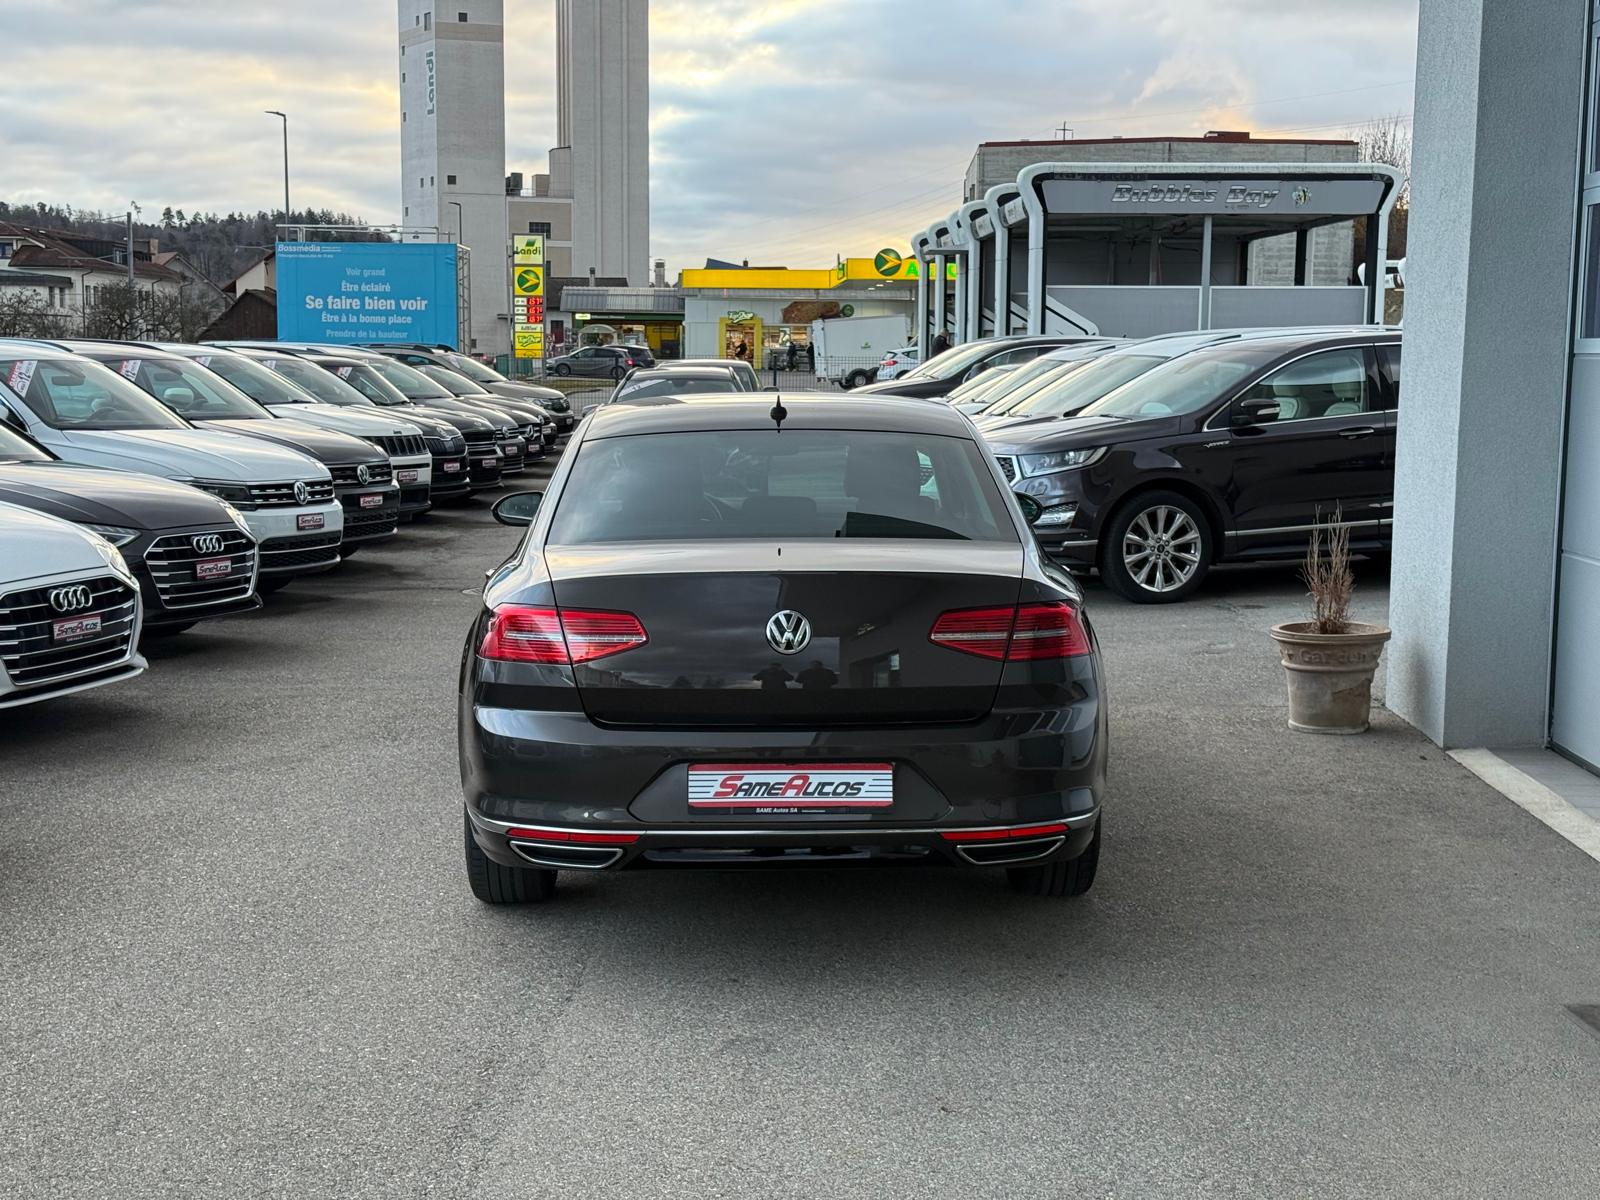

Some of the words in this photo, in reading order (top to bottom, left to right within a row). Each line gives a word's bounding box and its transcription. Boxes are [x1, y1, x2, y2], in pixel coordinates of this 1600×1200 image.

[425, 51, 435, 115] Landi
[1111, 184, 1218, 203] Bubbles
[1226, 185, 1280, 209] Bay
[515, 246, 541, 255] Landi
[345, 267, 361, 276] Voir
[363, 267, 385, 278] grand
[341, 280, 359, 292] Être
[361, 282, 391, 292] éclairé
[305, 295, 323, 309] Se
[327, 295, 361, 310] faire
[365, 296, 395, 310] bien
[399, 297, 428, 311] voir
[322, 311, 339, 322] Être
[341, 313, 347, 322] à
[349, 314, 357, 323] la
[360, 314, 386, 324] bonne
[388, 314, 412, 325] place
[326, 329, 356, 338] Prendre
[357, 330, 367, 338] de
[369, 330, 376, 338] la
[378, 330, 408, 339] hauteur
